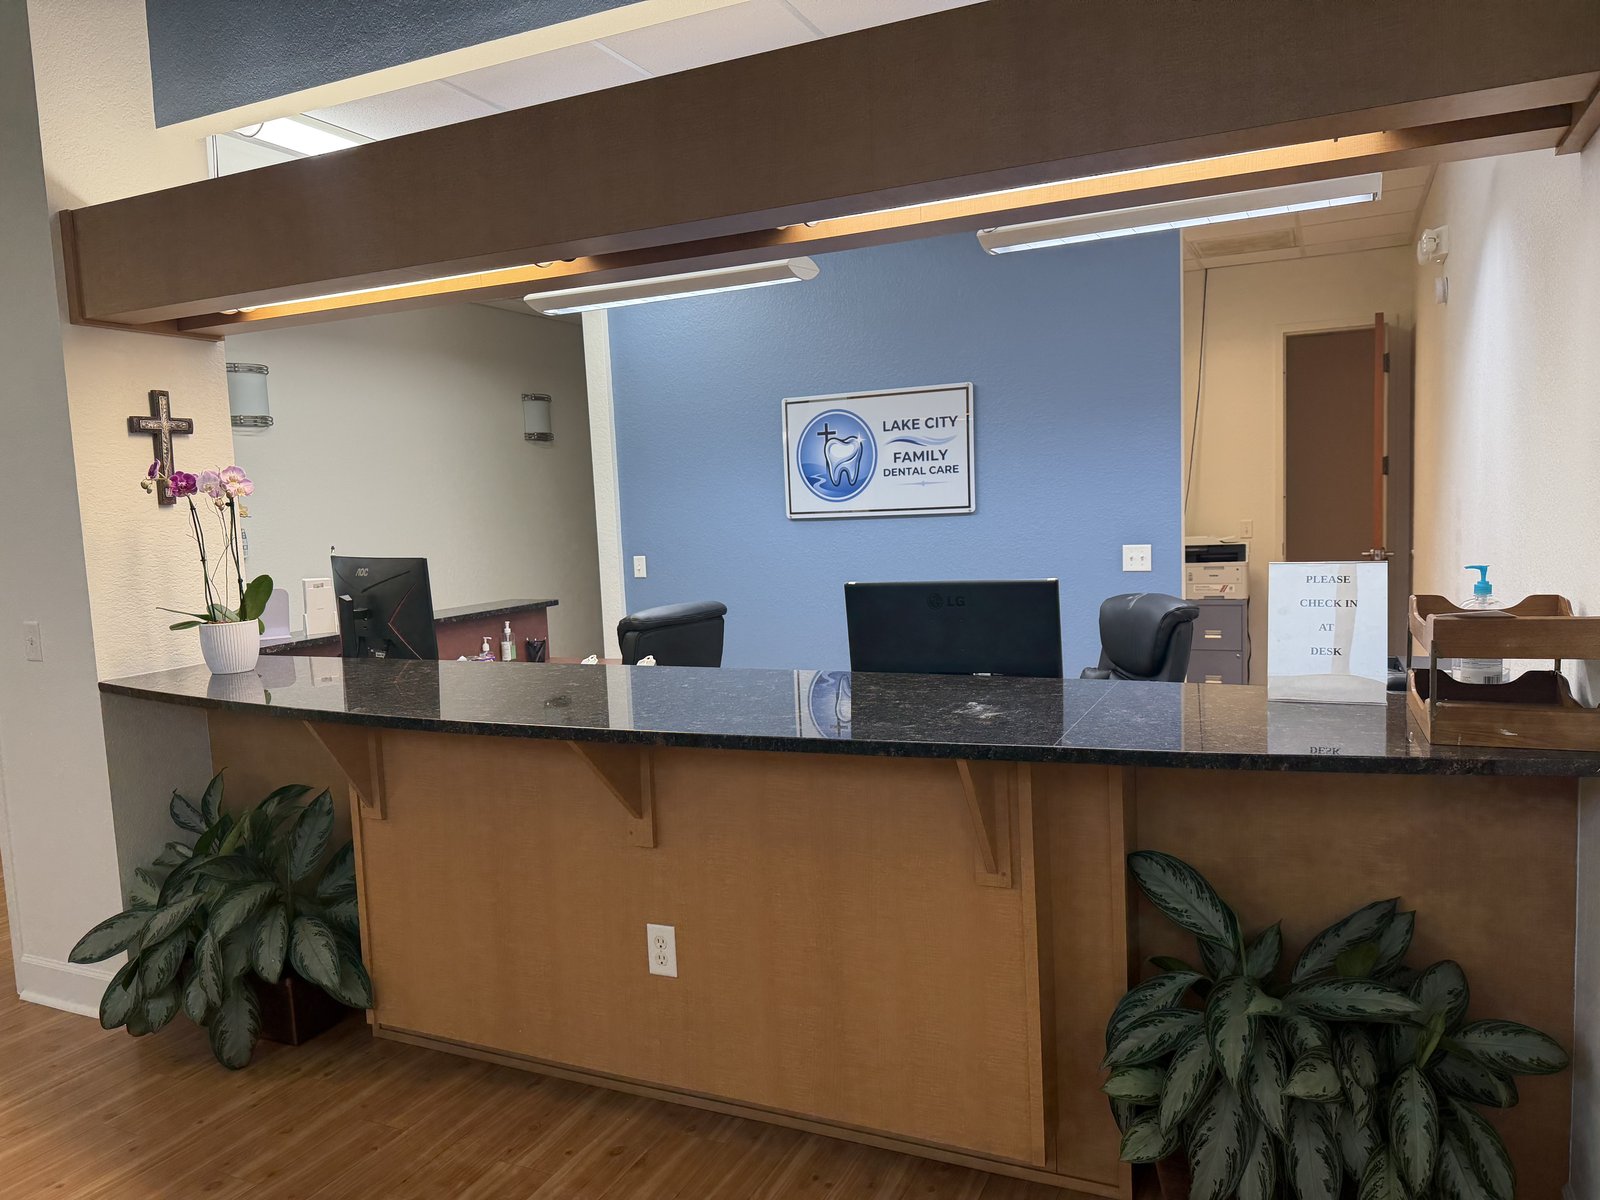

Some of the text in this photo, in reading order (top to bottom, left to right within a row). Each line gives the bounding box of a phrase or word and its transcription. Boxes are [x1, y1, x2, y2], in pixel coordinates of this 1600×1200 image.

[882, 415, 958, 432] LAKE CITY
[893, 449, 948, 463] FAMILY
[883, 464, 959, 477] DENTAL CARE
[355, 568, 369, 576] AOC
[1306, 575, 1351, 584] PLEASE
[1299, 599, 1358, 608] CHECK IN
[1318, 623, 1335, 632] AT
[1310, 647, 1342, 656] DESK
